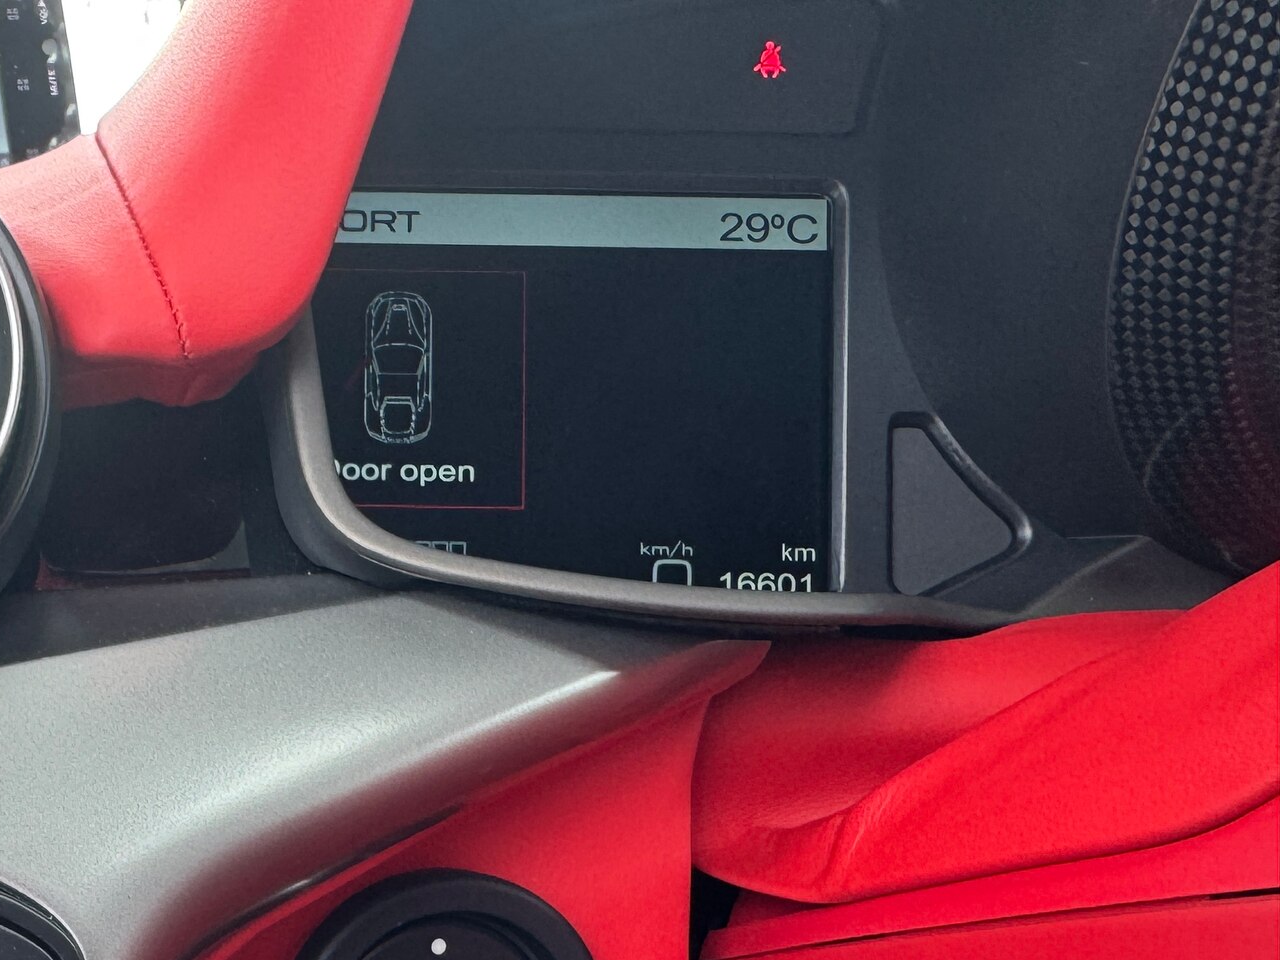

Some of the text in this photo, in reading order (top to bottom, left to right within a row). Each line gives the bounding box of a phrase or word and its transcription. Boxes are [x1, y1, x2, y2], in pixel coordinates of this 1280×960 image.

[339, 209, 421, 233] ORT
[334, 459, 475, 486] oor open
[639, 540, 694, 558] km/h
[781, 543, 816, 562] km
